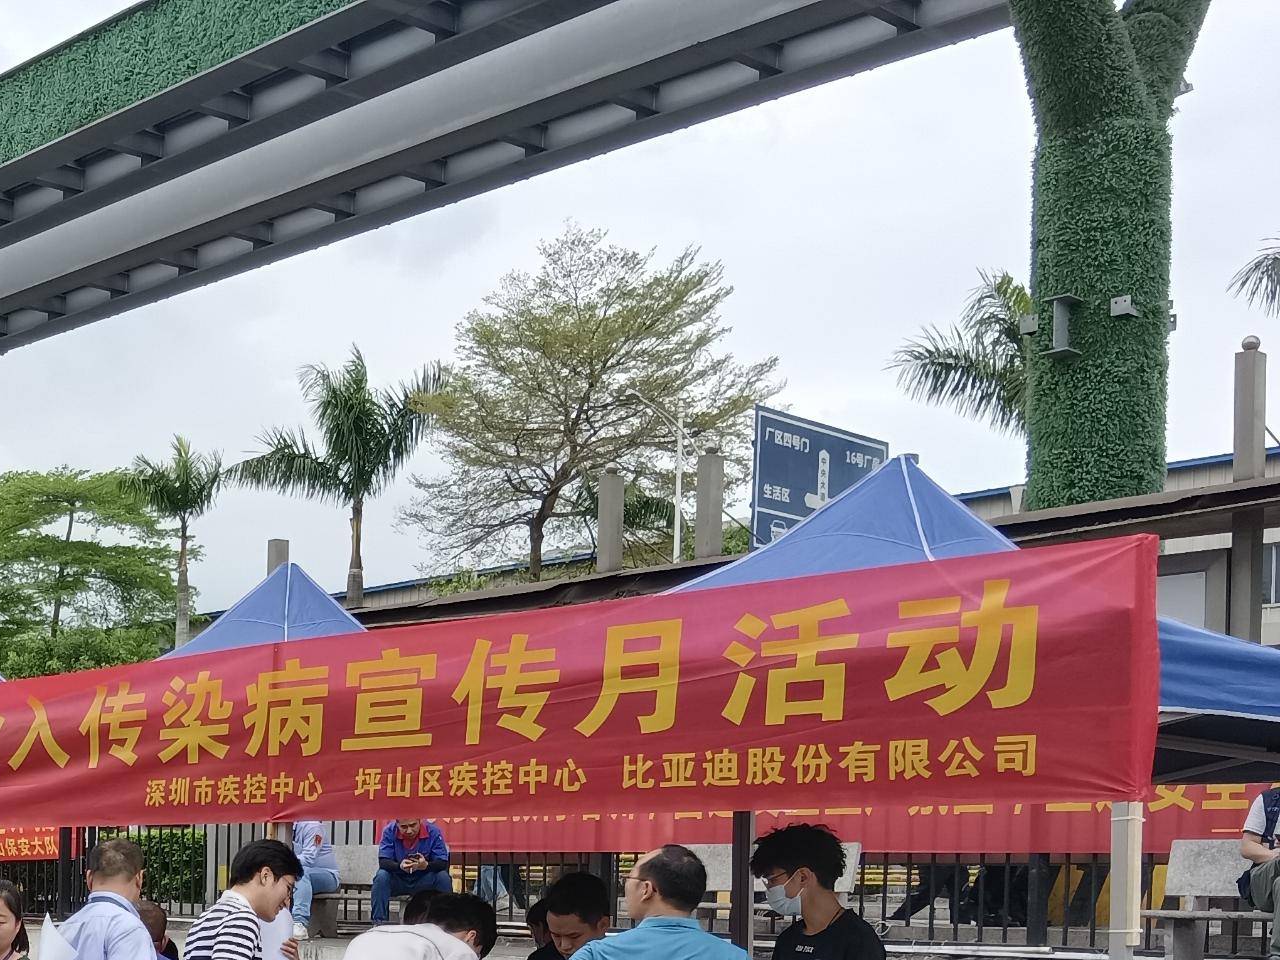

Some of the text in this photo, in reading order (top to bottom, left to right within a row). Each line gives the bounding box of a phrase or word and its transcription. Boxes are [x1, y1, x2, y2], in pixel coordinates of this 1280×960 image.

[765, 428, 810, 452] 厂区四号门
[763, 484, 791, 503] 生活区
[144, 734, 1038, 808] 深圳市疾控中心 坪山区疾控中心 比亚迪股份有限公司
